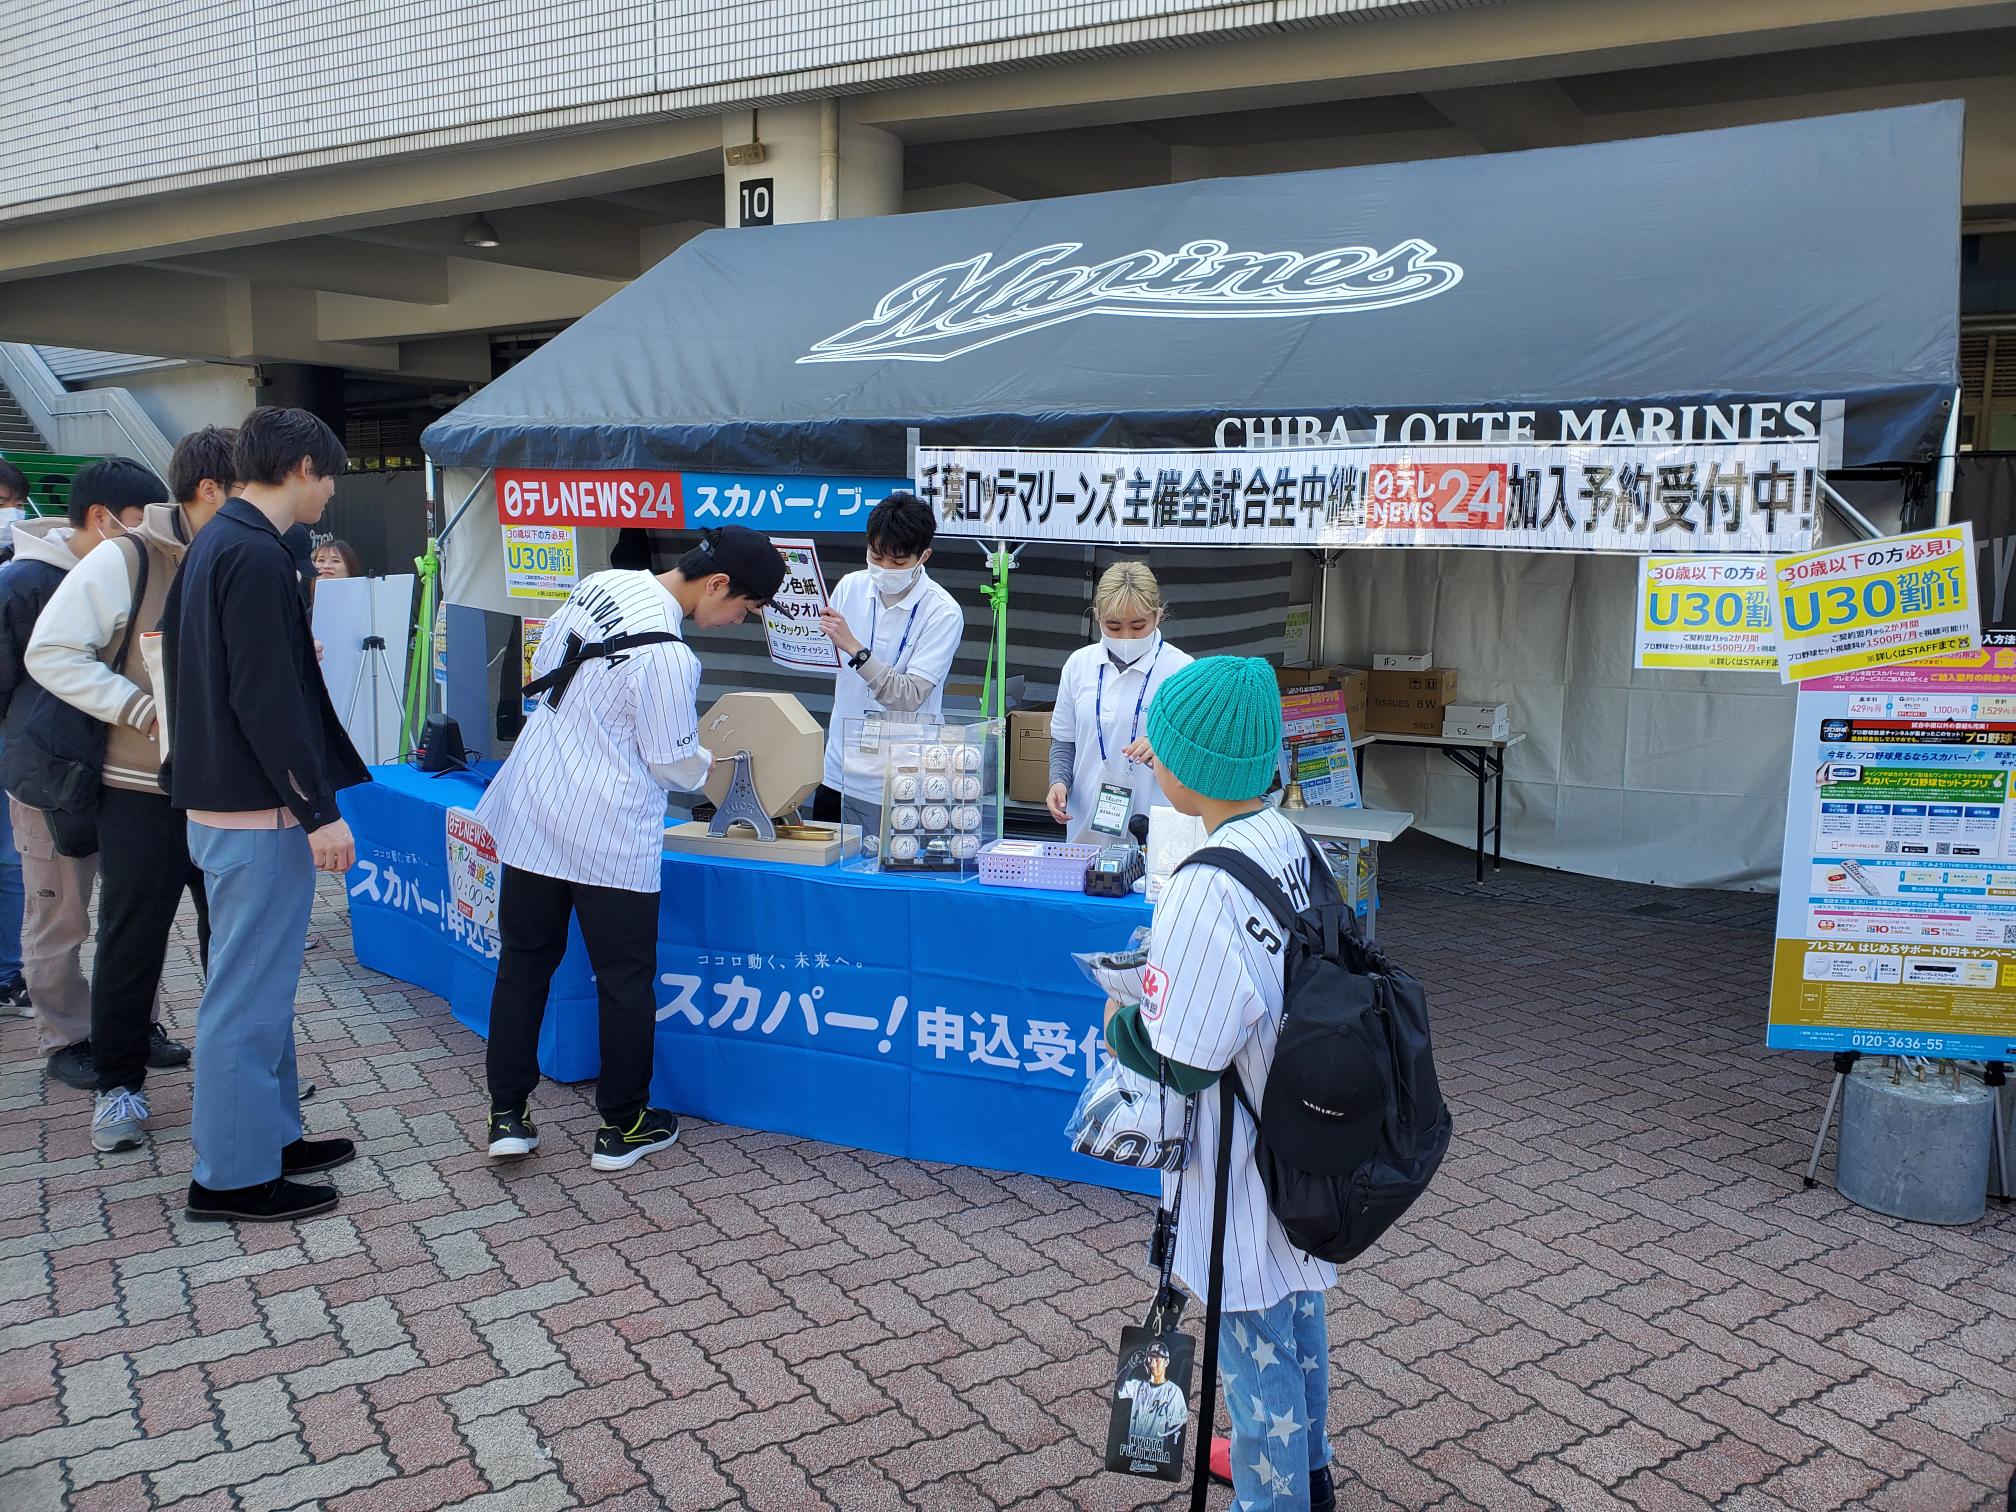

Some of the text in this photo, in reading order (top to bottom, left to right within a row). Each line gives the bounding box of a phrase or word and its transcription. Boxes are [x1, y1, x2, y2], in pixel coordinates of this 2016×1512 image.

[743, 187, 769, 219] 10
[795, 239, 1464, 363] Marines
[1216, 401, 1817, 448] CHIBA LOTTE MARINES
[1373, 503, 1437, 523] NEWS
[1437, 470, 1503, 523] 24
[1504, 461, 1815, 535] 加入予約受付中!
[508, 547, 549, 571] U30
[1649, 591, 1769, 627] U30 初
[1784, 579, 1896, 631] U30
[697, 951, 865, 970] ココロ動く、未来へ。
[654, 972, 909, 1054] スカパー!
[1852, 1034, 1944, 1051] 0120-3636-55
[1120, 1443, 1171, 1463] FUJIWARA
[1129, 1434, 1163, 1450] KYOTA
